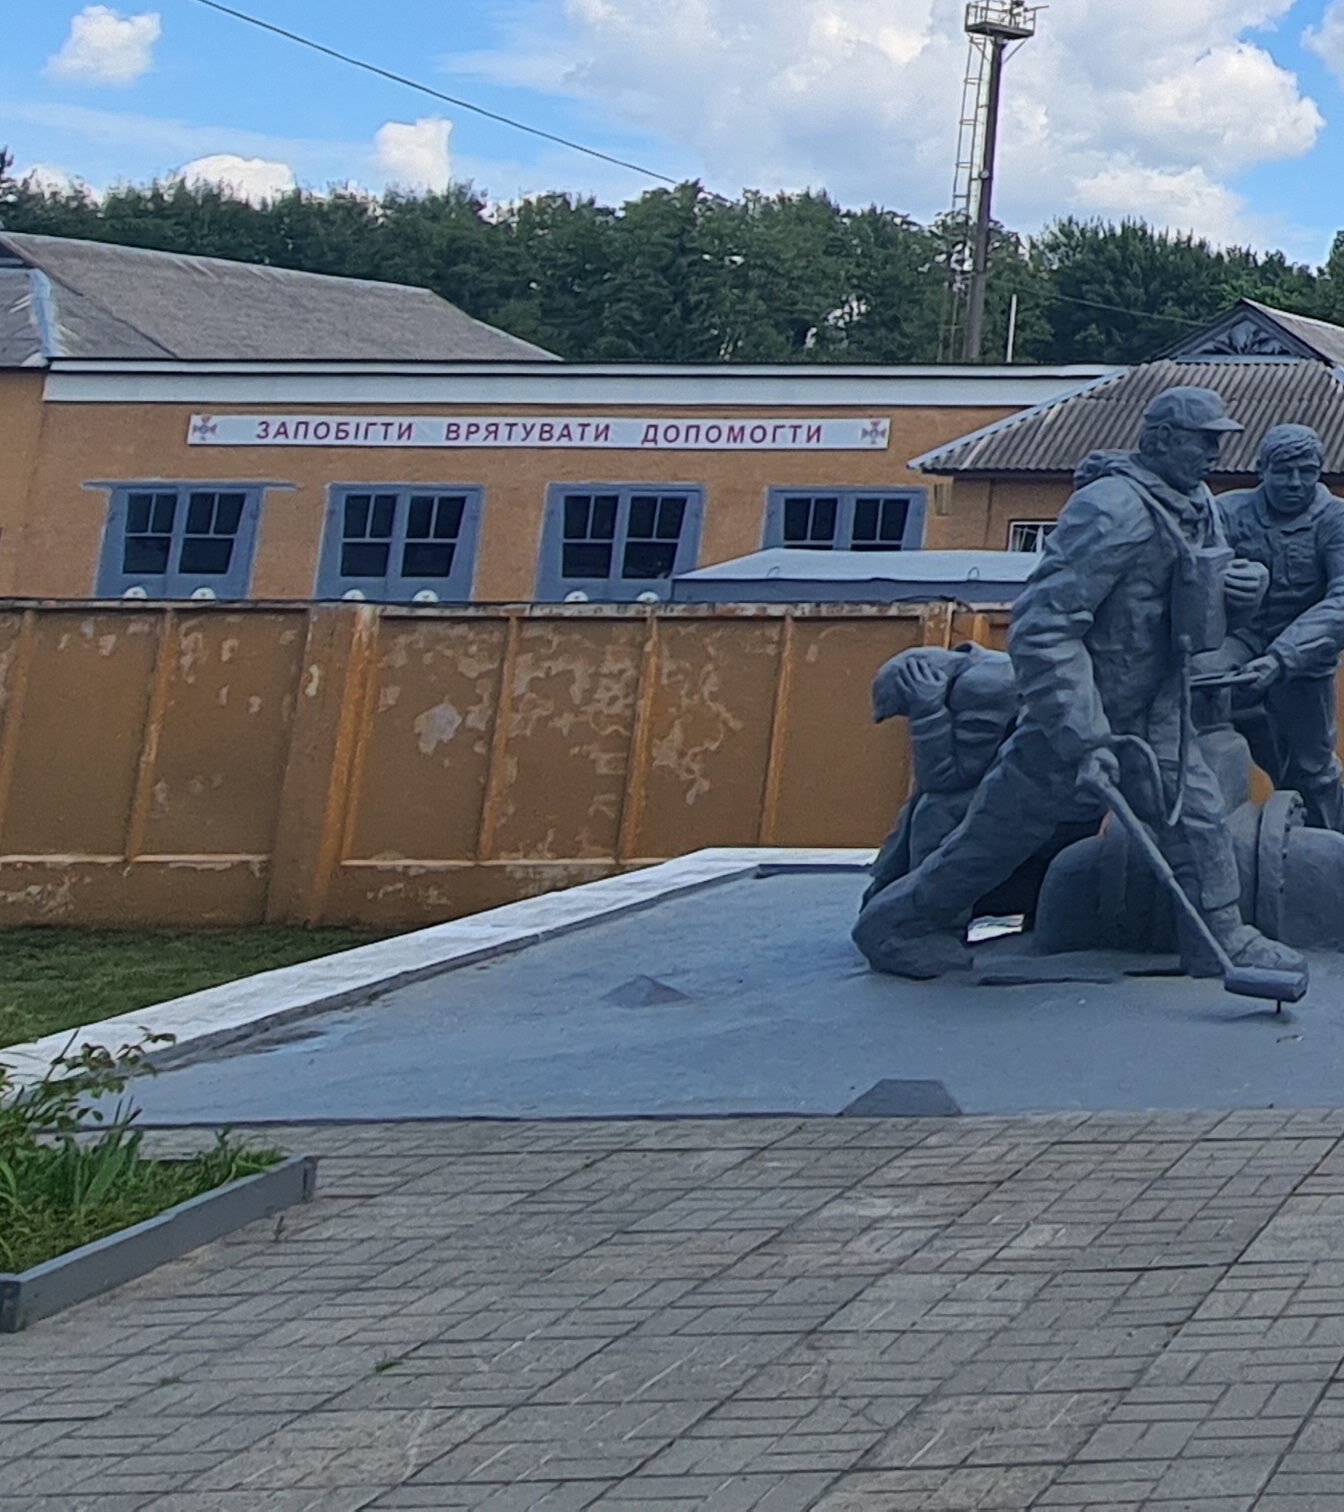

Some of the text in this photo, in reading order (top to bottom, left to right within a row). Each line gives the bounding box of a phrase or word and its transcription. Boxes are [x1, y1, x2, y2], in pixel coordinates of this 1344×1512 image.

[256, 421, 823, 445] ЗАПОБІГТИ ВРЯТУВАТИ ДОПОМОГТИ
